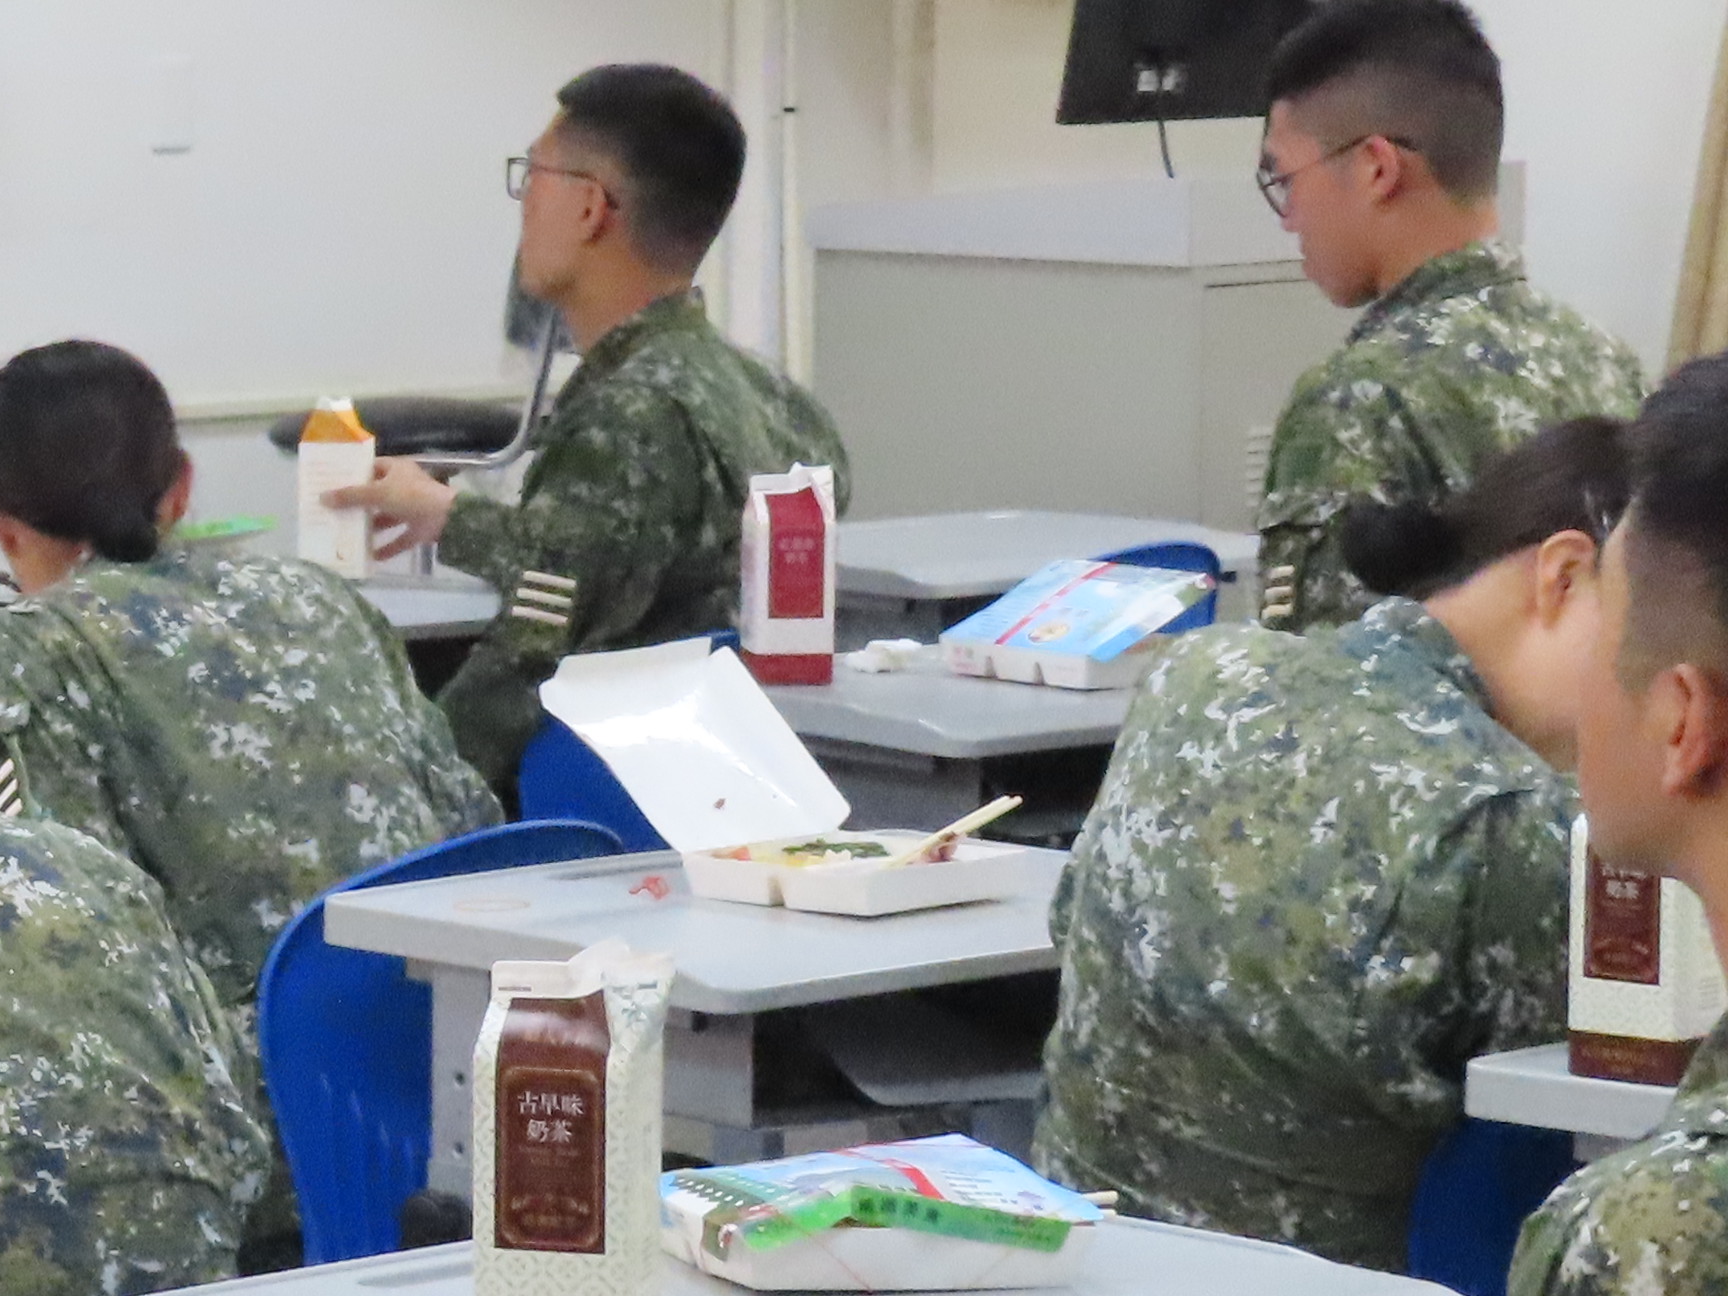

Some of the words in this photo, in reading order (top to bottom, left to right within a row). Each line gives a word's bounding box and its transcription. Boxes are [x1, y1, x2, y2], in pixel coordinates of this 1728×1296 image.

[517, 1090, 584, 1116] 古早味
[526, 1118, 573, 1144] 奶茶
